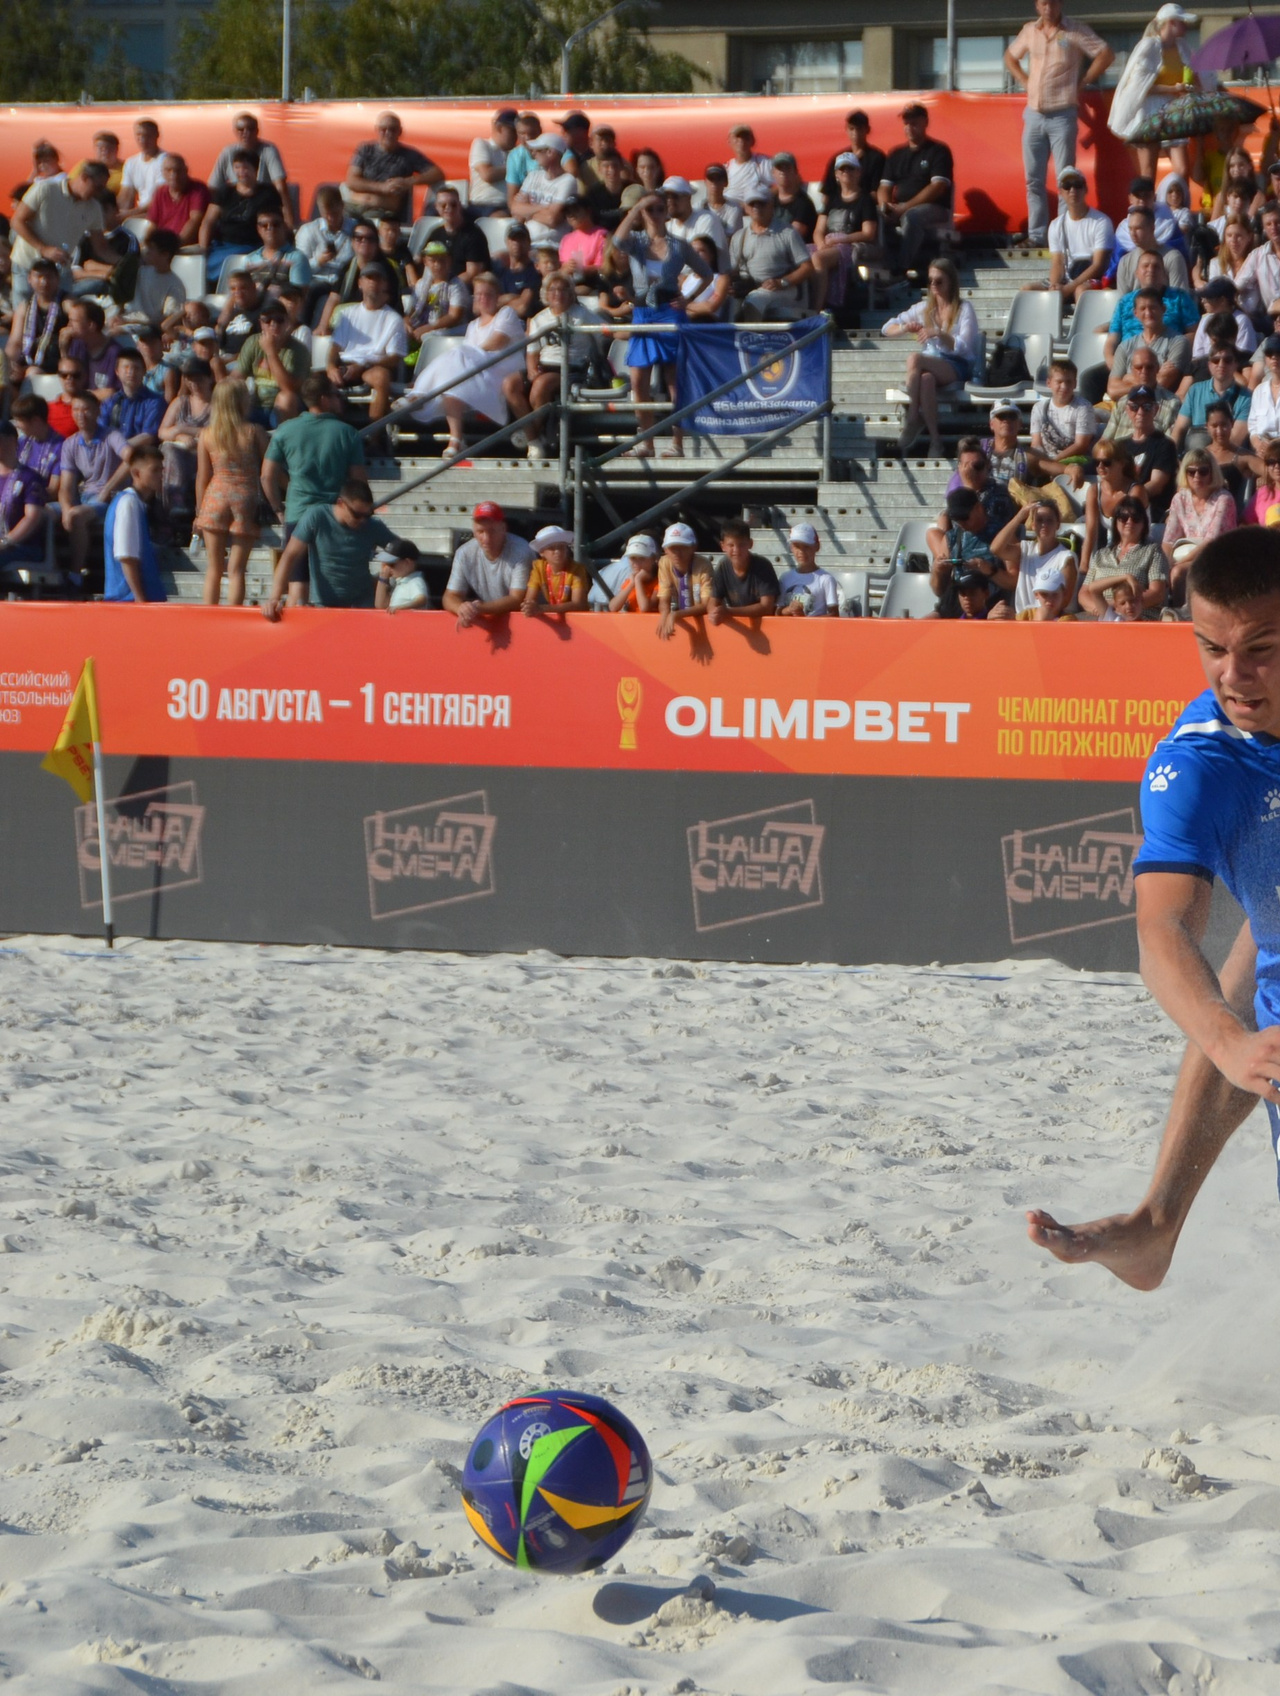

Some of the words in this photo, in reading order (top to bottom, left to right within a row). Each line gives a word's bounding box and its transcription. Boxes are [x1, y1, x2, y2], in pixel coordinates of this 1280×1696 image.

[0, 689, 75, 706] ТБОЛЬНЫЙ
[167, 678, 208, 720] 30
[216, 687, 323, 722] АВГУСТА
[360, 682, 374, 724] 1
[383, 691, 511, 727] СЕНТЯБРЯ
[998, 697, 1119, 725] ЧЕМПИОНАТ
[664, 695, 971, 743] OLIMPBET
[998, 729, 1023, 755] ПО
[1030, 730, 1153, 758] ПЛЯЖНОМУ
[375, 810, 477, 854] НАША
[698, 820, 804, 864] НАША
[370, 848, 487, 884] СМЕНА
[1013, 829, 1125, 874] НАША
[692, 859, 812, 895] СМЕНА
[1006, 868, 1137, 906] СМЕНА
